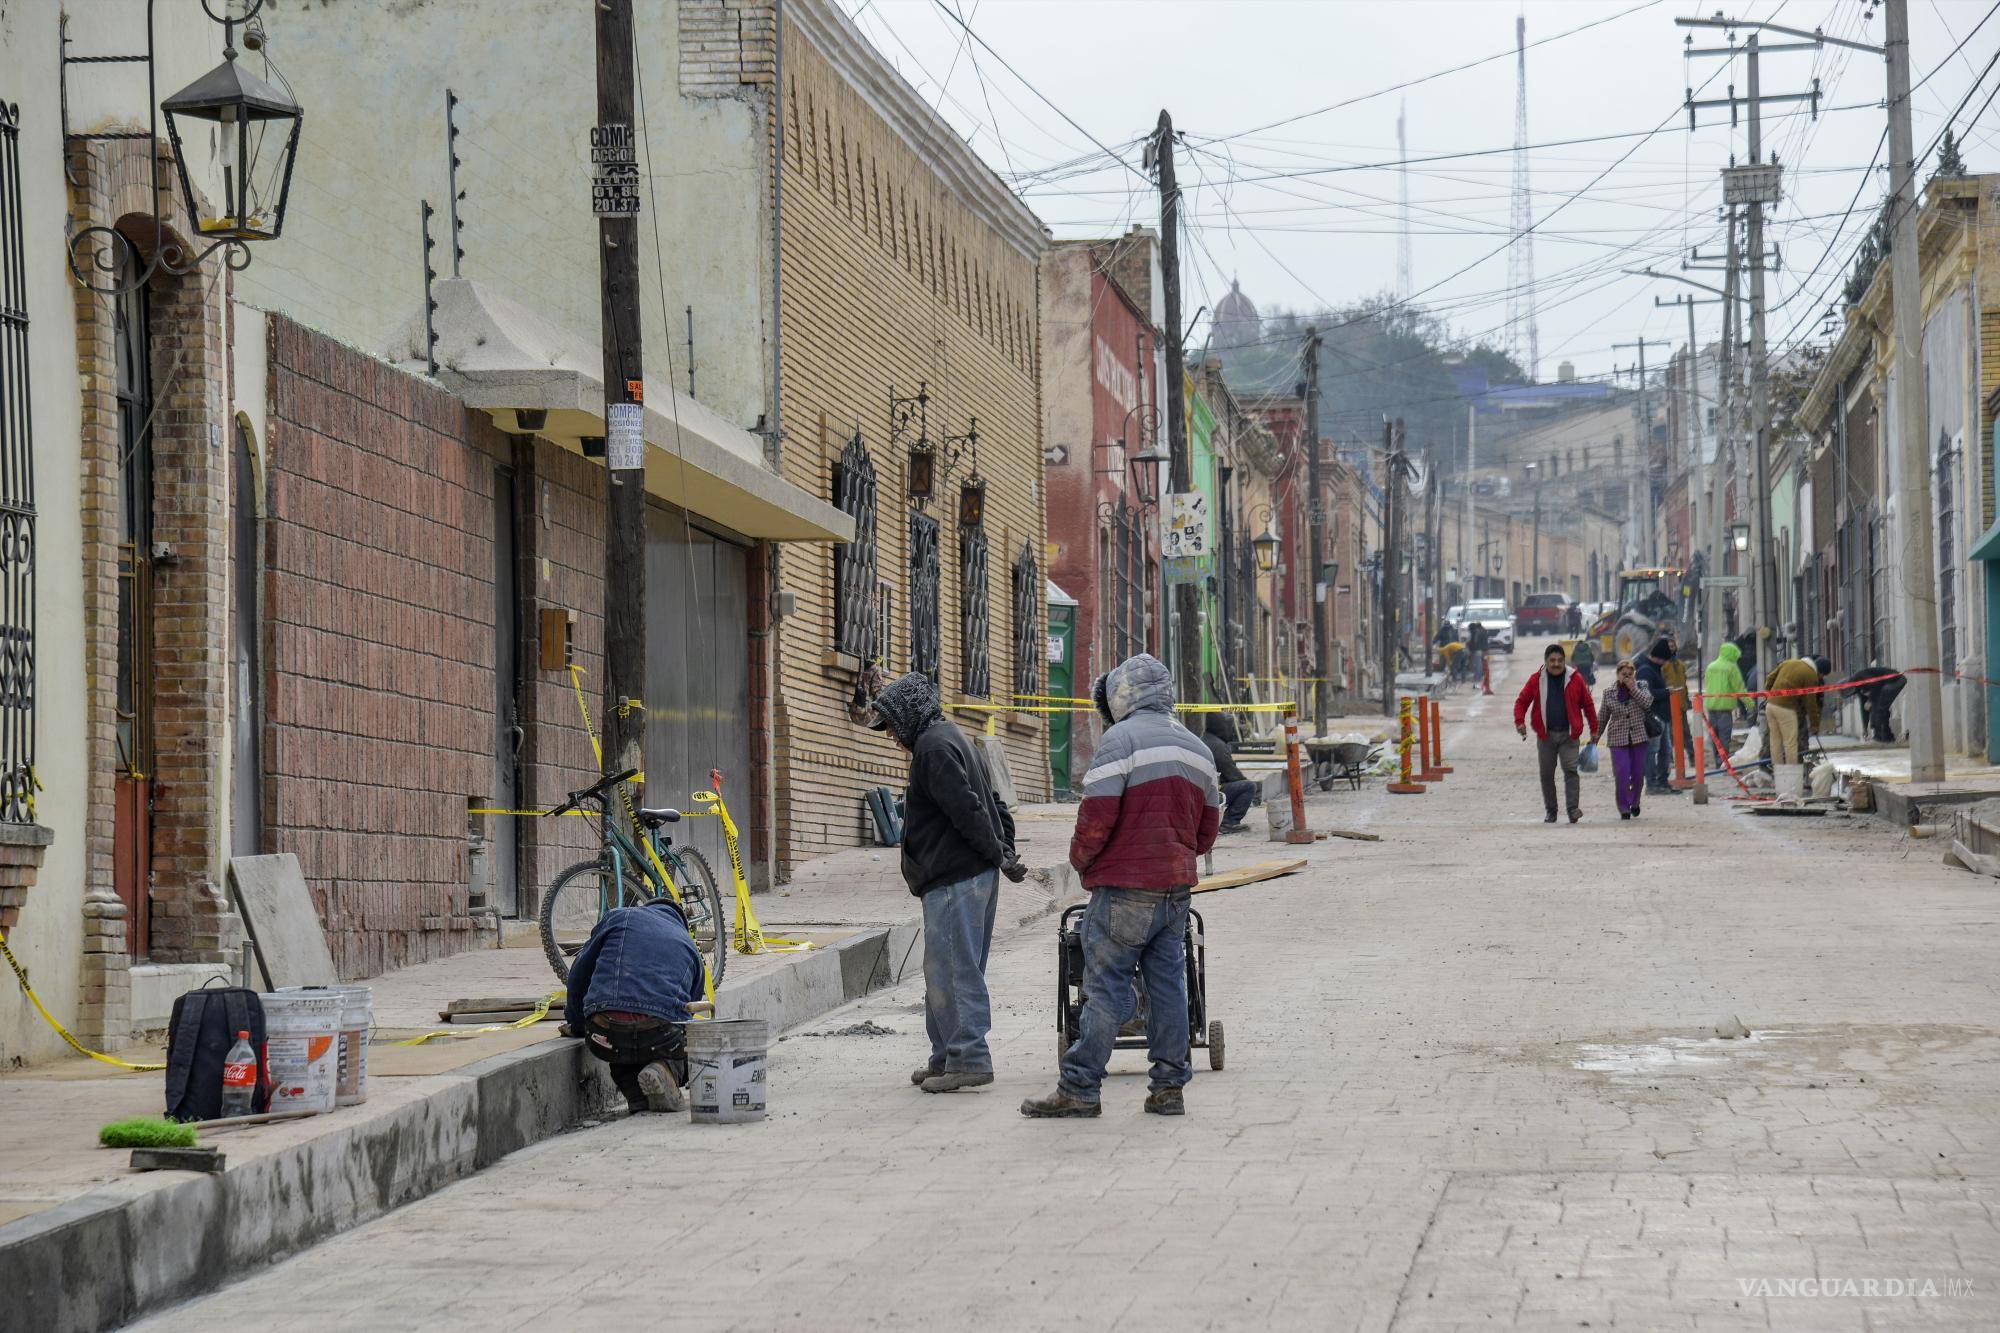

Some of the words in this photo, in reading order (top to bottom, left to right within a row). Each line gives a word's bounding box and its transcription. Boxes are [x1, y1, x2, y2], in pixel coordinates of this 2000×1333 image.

[609, 406, 642, 418] COMPRO
[609, 446, 620, 454] 01
[625, 446, 642, 454] 800
[625, 455, 634, 466] 24
